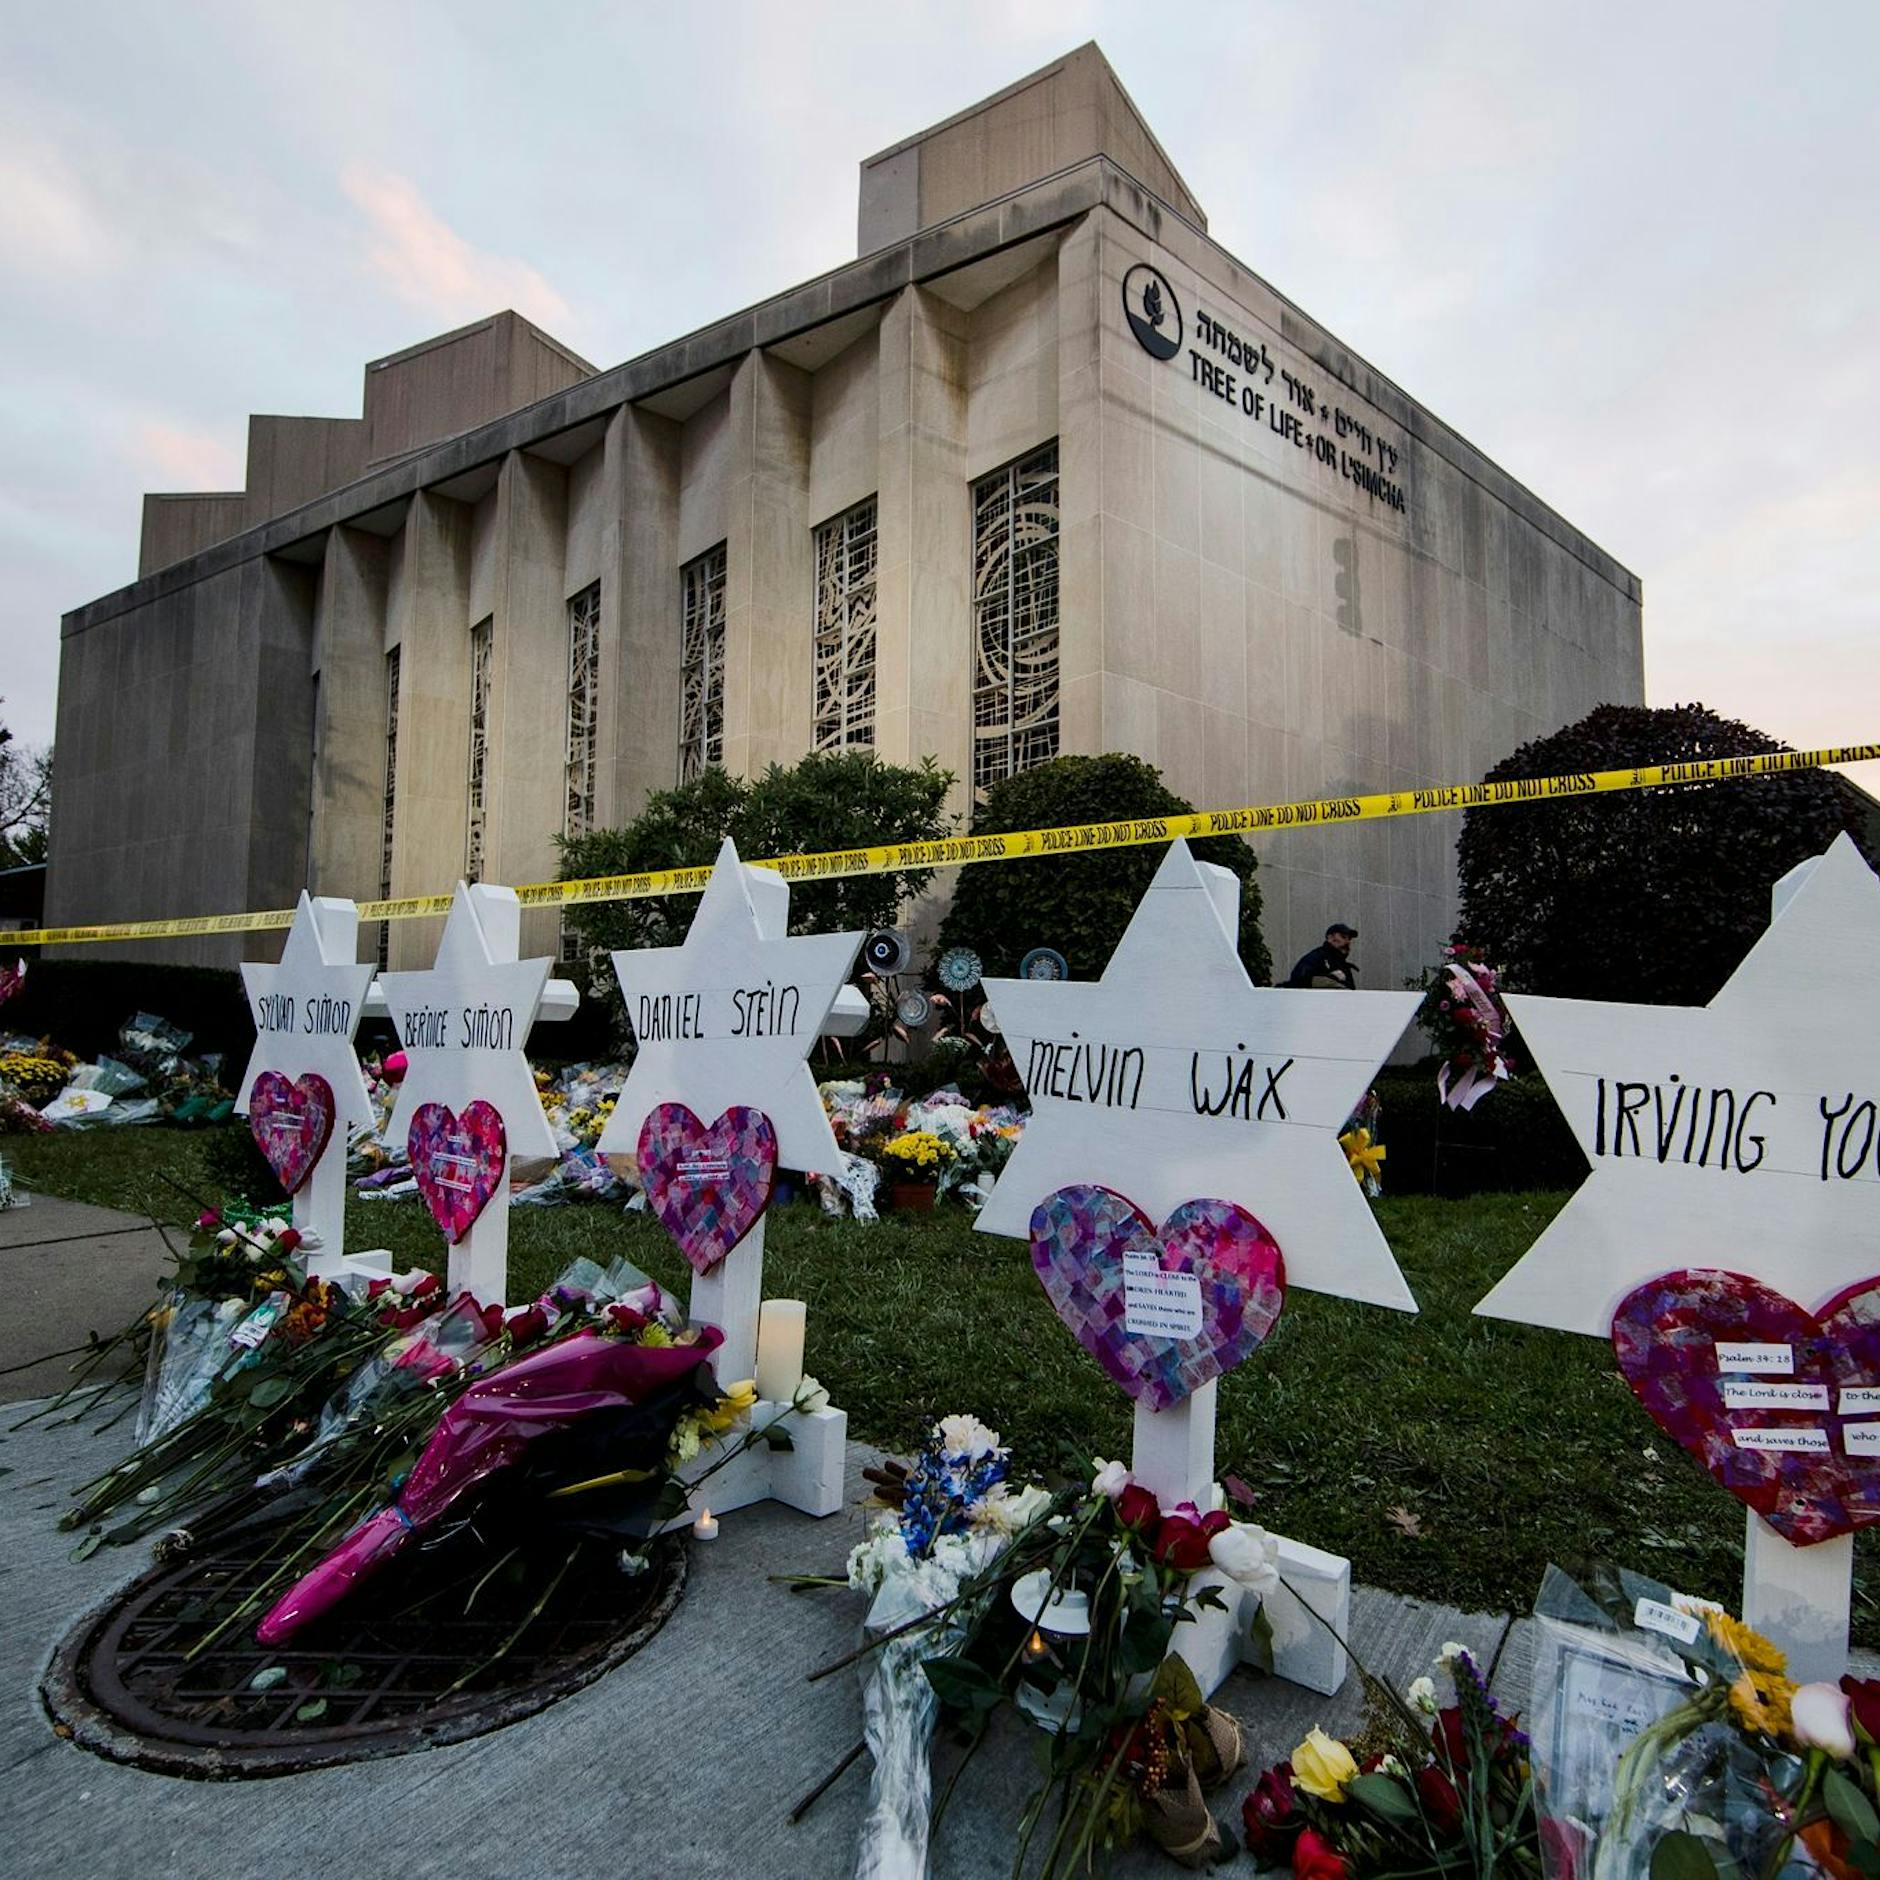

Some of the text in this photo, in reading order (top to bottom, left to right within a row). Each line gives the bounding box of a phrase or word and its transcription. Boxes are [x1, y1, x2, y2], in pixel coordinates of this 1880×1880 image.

[1197, 310, 1275, 385] לשמחה
[1188, 349, 1237, 406] TREE
[1242, 387, 1265, 422] OF
[1270, 403, 1303, 448] LIFE
[1316, 434, 1337, 470] OR
[1281, 369, 1314, 416] אור
[1660, 762, 1716, 782] POLICE
[1720, 758, 1756, 775] LINE
[1761, 755, 1784, 772] DO
[1790, 750, 1820, 768] NOT
[1413, 773, 1596, 809] POLICE LINE DO NOT CROSS
[1210, 798, 1361, 832] POLICE LINE DO NOT CROSS
[898, 837, 1006, 866] POLICE LINE DO NOT CROSS
[1041, 820, 1167, 850] POLICE LINE DO NOT CROSS
[304, 993, 351, 1035] SIMON
[405, 1002, 513, 1050] BERNICE SIMON
[639, 980, 800, 1041] DANIEL STEIN
[1026, 1032, 1294, 1120] MELVIN WAX
[1596, 1074, 1880, 1181] IRVING YO
[1718, 1353, 1753, 1364] Psalm
[1727, 1388, 1746, 1398] The
[1749, 1388, 1777, 1398] Lord
[1846, 1392, 1859, 1400] to
[1737, 1431, 1878, 1447] and saves those who
